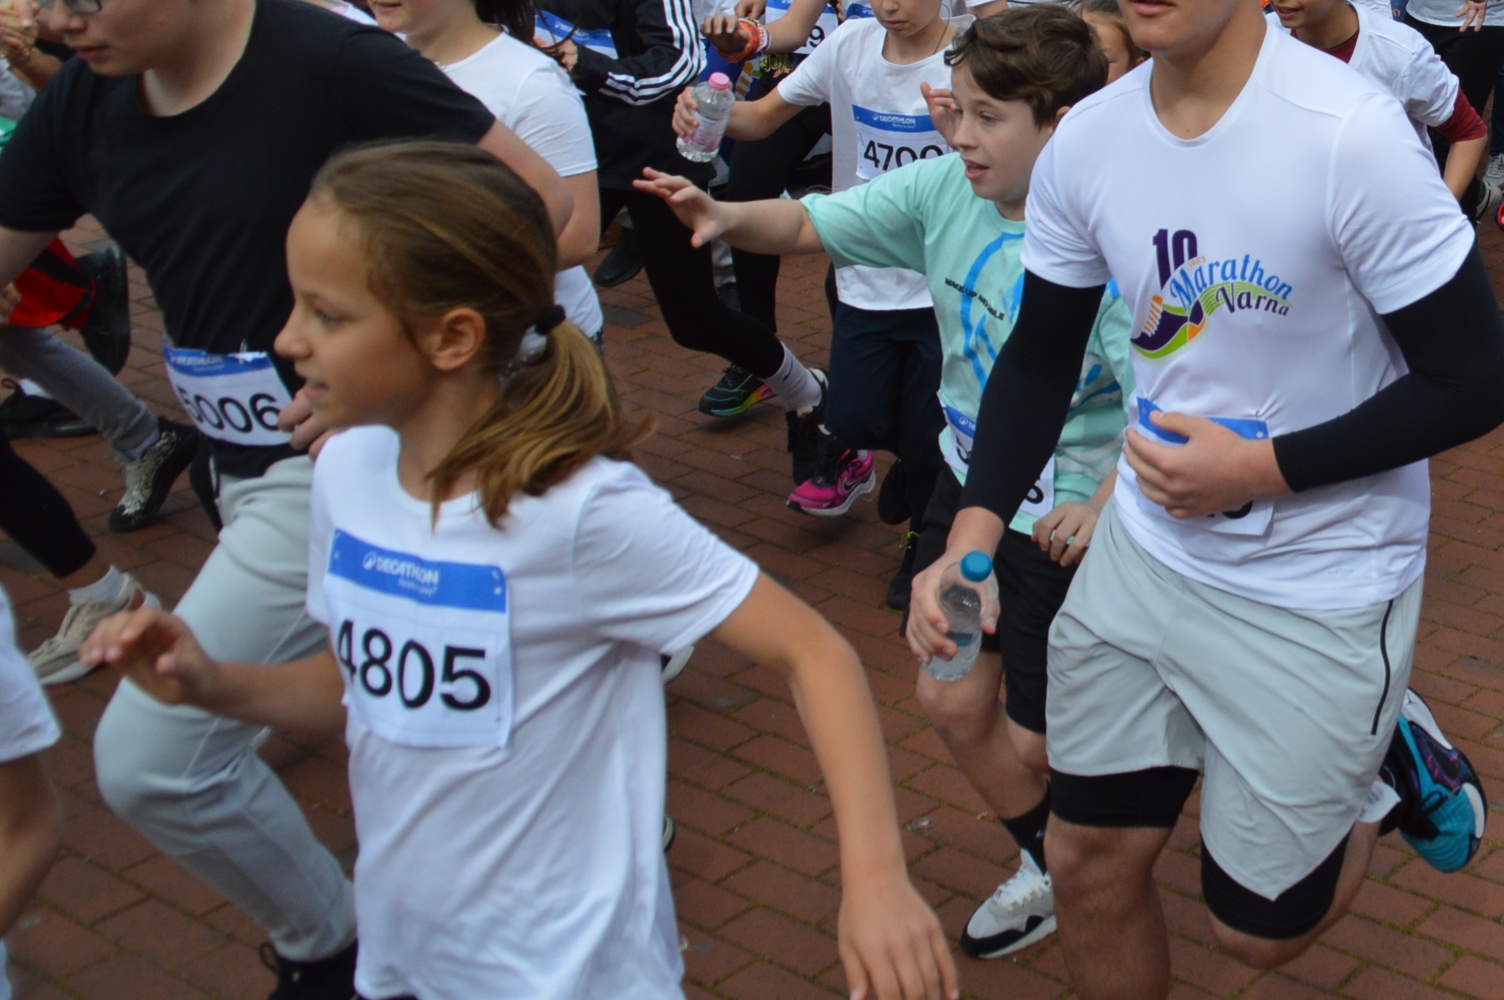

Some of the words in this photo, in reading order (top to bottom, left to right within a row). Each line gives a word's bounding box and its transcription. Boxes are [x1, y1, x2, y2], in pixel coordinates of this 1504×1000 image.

[1152, 228, 1198, 291] 10
[1169, 253, 1294, 313] Marathon
[1215, 282, 1290, 317] Varna
[176, 384, 281, 433] 5006
[337, 619, 491, 712] 4805
